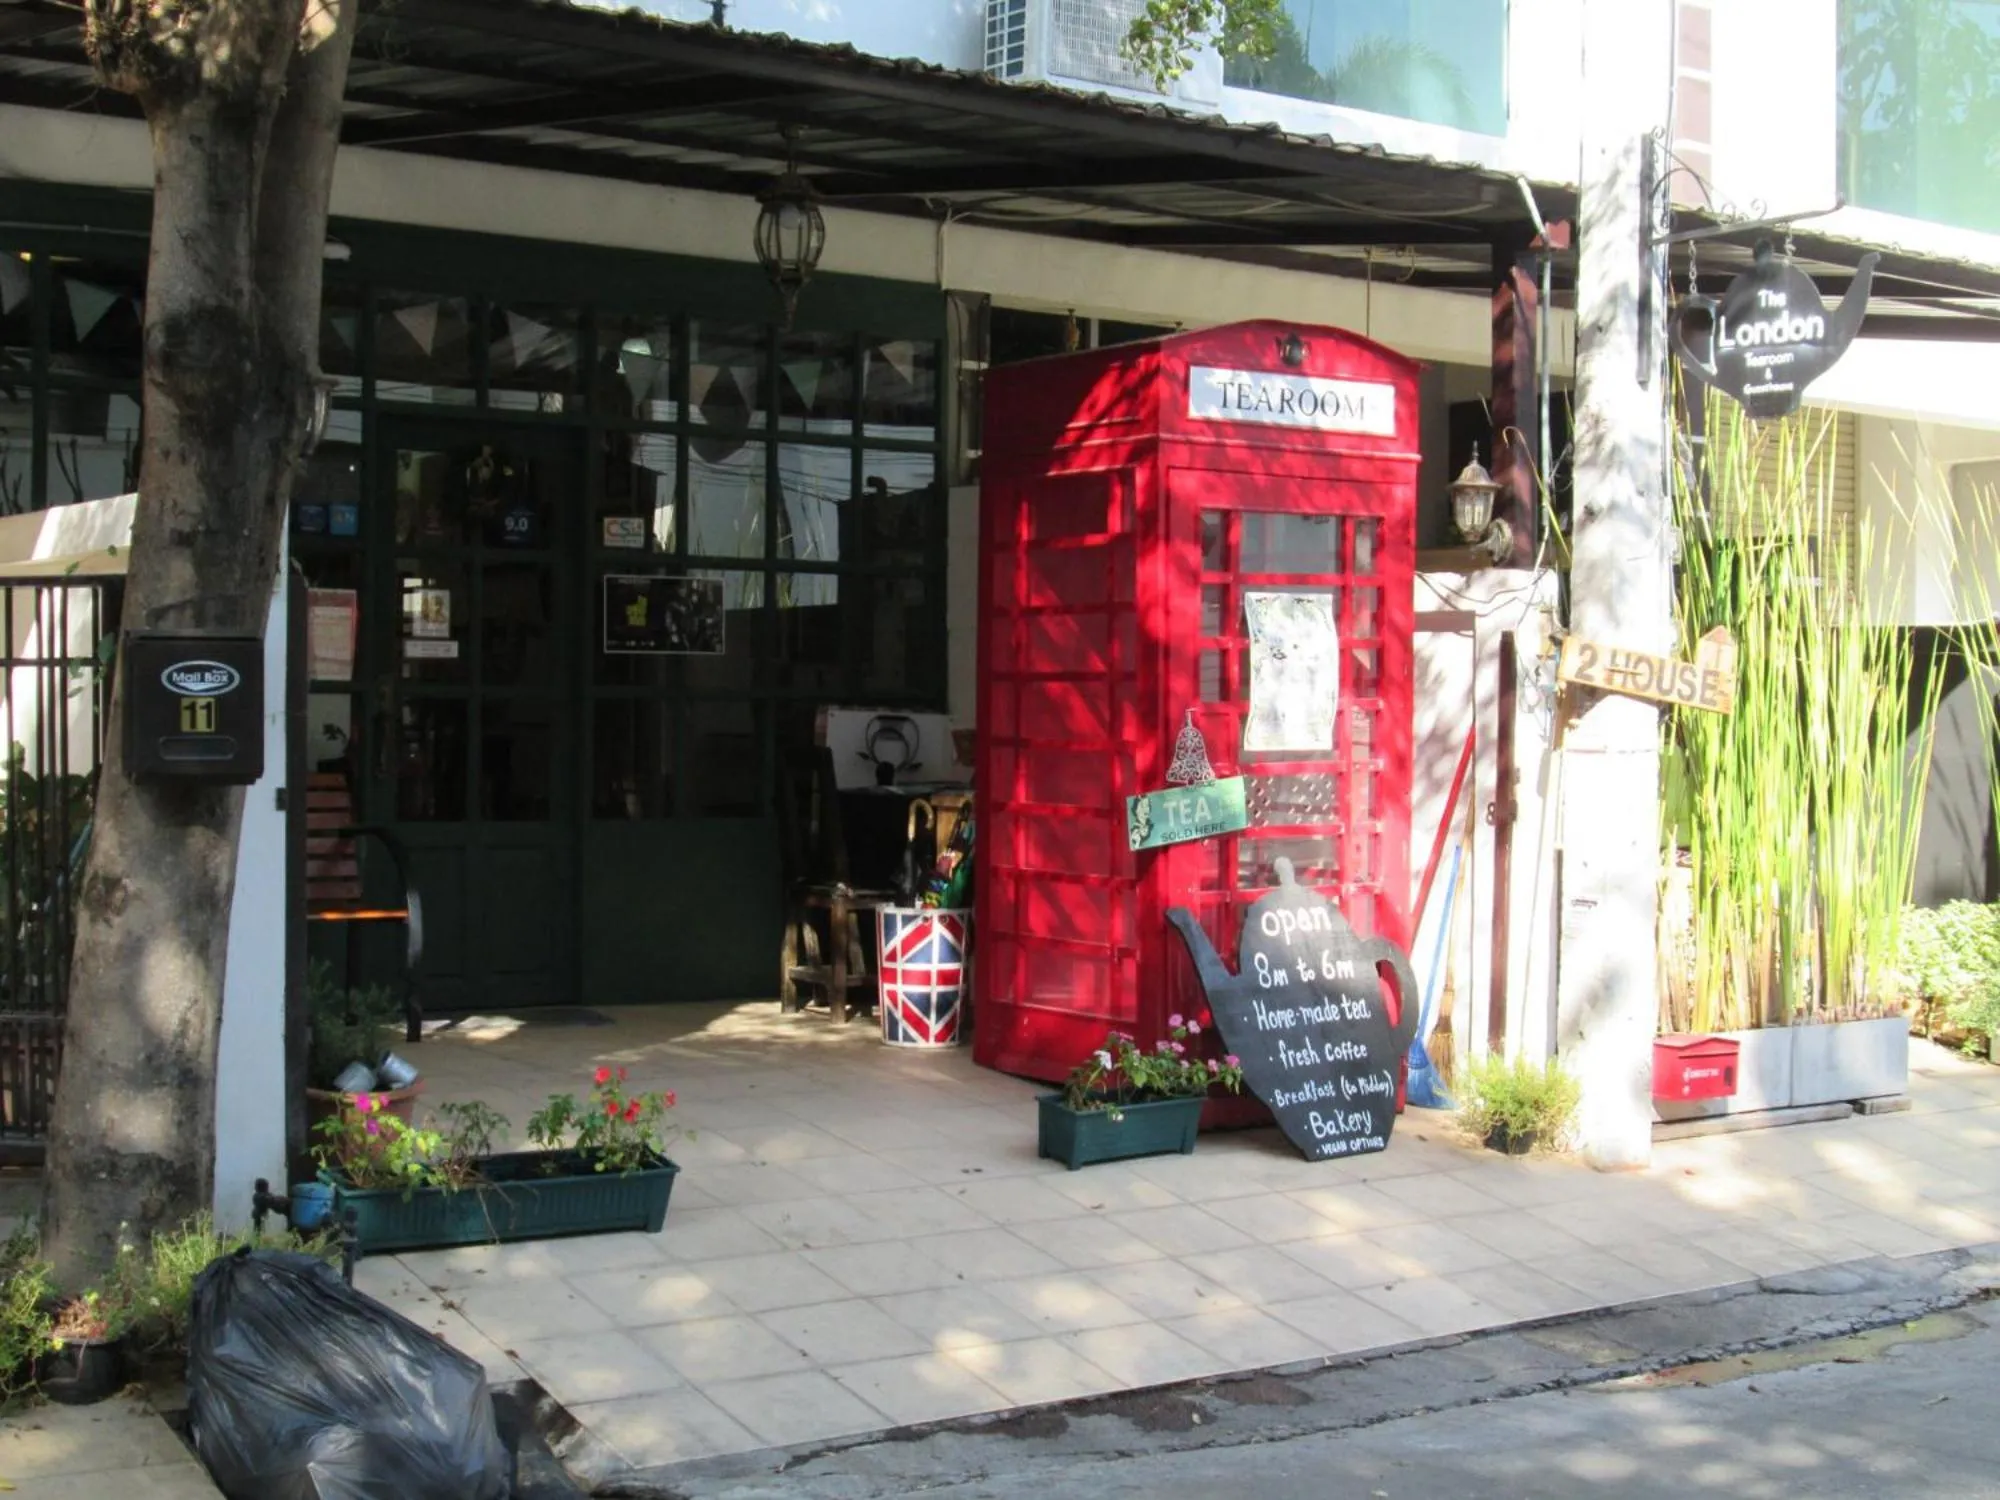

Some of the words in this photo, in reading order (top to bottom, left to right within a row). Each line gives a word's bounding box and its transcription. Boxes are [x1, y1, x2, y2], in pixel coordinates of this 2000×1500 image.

[1758, 288, 1786, 308] The
[1718, 309, 1825, 347] London
[1743, 352, 1795, 367] Tearoom
[1217, 380, 1365, 421] TEAROOM
[504, 516, 529, 533] 9.0
[172, 671, 201, 682] Mail
[204, 671, 229, 682] Box
[1574, 643, 1599, 682] 2
[1603, 648, 1722, 706] HOUSE
[183, 700, 213, 730] 11
[1162, 796, 1213, 827] TEA
[1161, 828, 1193, 841] SOLD
[1195, 822, 1225, 836] HERE
[1261, 906, 1332, 945] open
[1296, 956, 1316, 983] to
[1340, 993, 1372, 1020] tea
[1278, 1035, 1321, 1070] fresh
[1273, 1079, 1336, 1107] Breakfast
